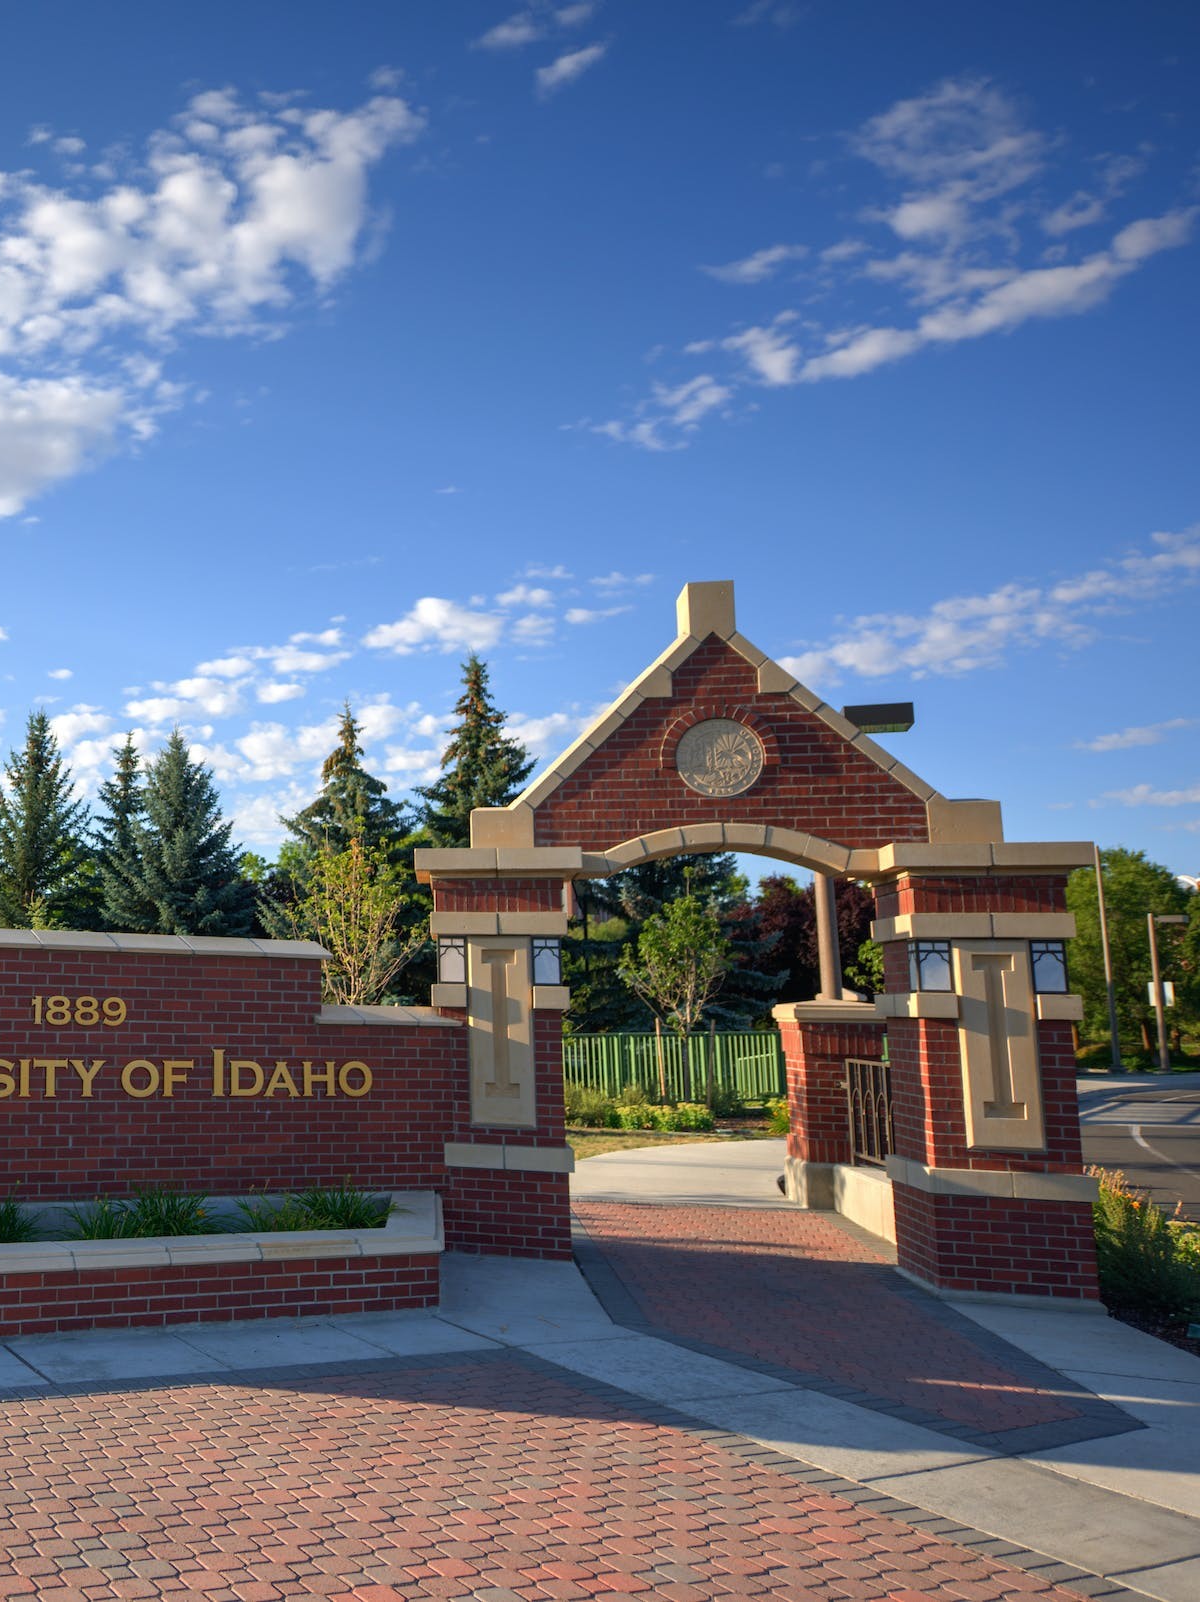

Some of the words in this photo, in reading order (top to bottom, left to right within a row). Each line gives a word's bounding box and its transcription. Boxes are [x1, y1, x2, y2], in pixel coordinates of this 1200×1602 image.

[31, 995, 127, 1026] 1889
[121, 1059, 194, 1097] OF
[212, 1049, 373, 1097] IDAHO
